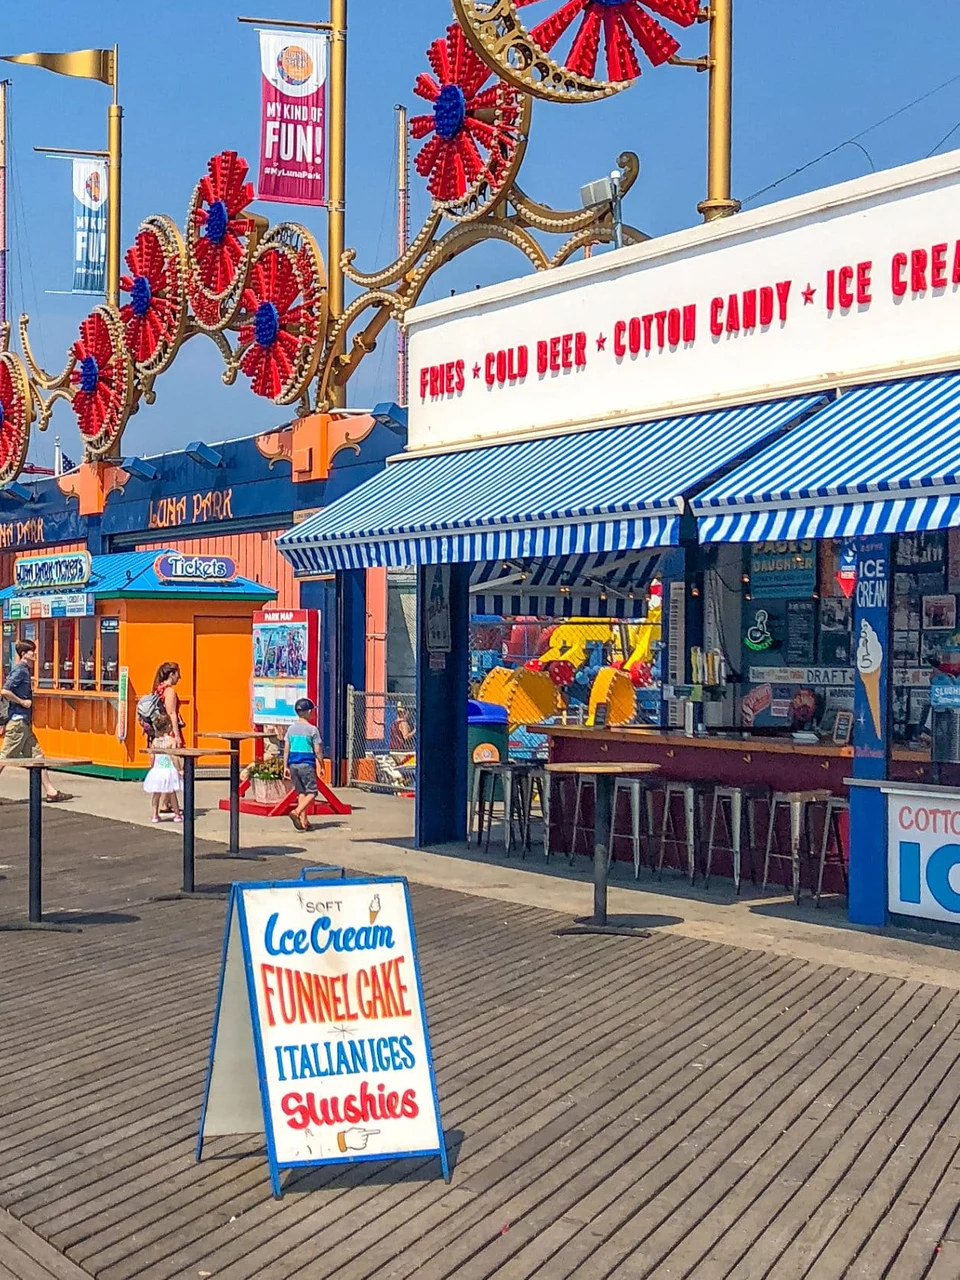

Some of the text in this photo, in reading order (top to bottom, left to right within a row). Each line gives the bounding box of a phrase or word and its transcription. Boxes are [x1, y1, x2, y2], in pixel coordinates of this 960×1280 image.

[266, 102, 323, 122] MY KIND OF
[265, 121, 322, 164] FUN!
[264, 167, 321, 180] #MyLunaPark
[76, 231, 106, 261] FU!
[420, 359, 465, 398] FRIES
[485, 345, 528, 385] COLD
[537, 331, 586, 373] BEER
[613, 303, 696, 357] COTTON
[710, 280, 791, 336] CANDY
[827, 261, 872, 310] ICE
[148, 488, 233, 528] LUNA PARK
[17, 517, 45, 545] PARK
[752, 540, 813, 555] PAULS
[168, 556, 226, 578] Tickets
[753, 558, 813, 573] DAUGHTER
[860, 559, 885, 577] ICE
[856, 580, 887, 607] CREAM
[264, 611, 294, 621] PARK MAP
[806, 669, 848, 683] DRAFT
[305, 900, 343, 914] SOFT
[264, 912, 395, 956] Ice Cream
[260, 956, 412, 1027] FUNNEL CAKE
[275, 1034, 416, 1081] ITALIAN ICES
[281, 1081, 420, 1130] Slushies
